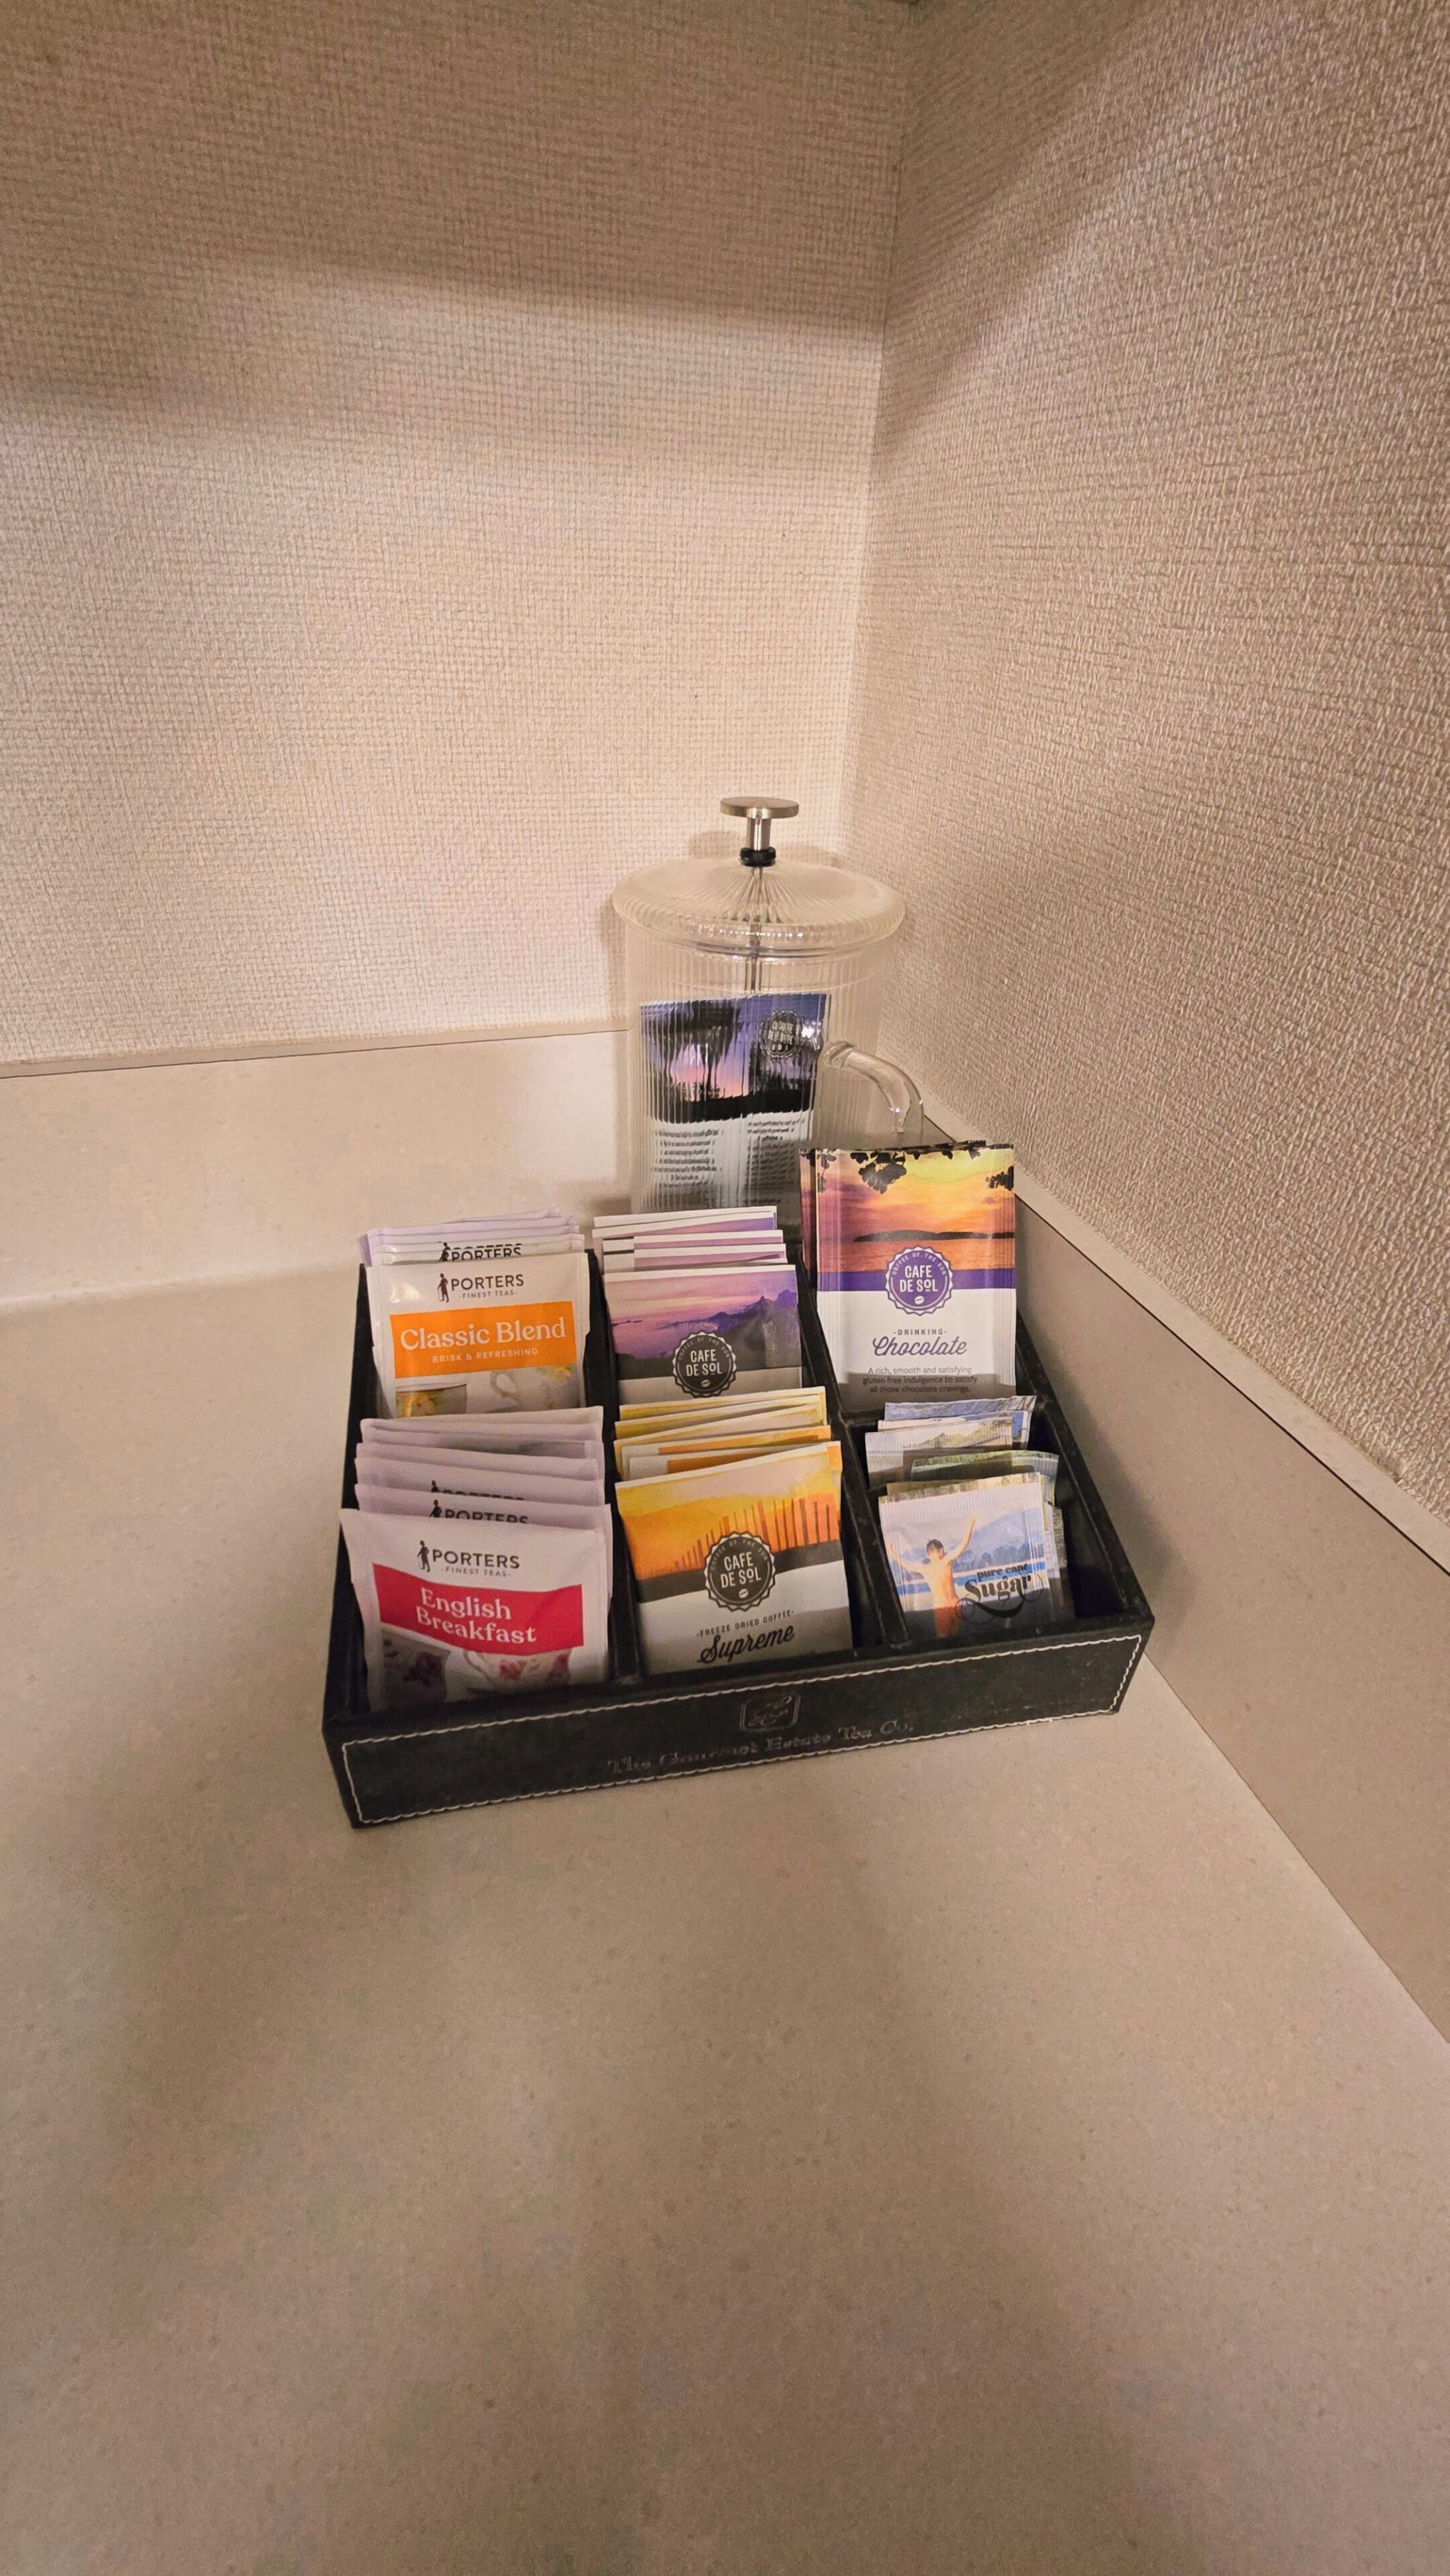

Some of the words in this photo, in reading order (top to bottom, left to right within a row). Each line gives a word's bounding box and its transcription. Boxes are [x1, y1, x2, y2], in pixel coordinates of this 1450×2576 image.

[905, 1265, 932, 1279] CAFE
[451, 1274, 524, 1291] PORTERS
[899, 1279, 913, 1293] DE
[400, 1324, 490, 1350] Classic
[496, 1316, 566, 1343] Blend
[873, 1336, 967, 1356] Chocolate
[433, 1354, 462, 1364] BRISK
[476, 1347, 539, 1360] REFRESHING
[691, 1349, 717, 1362] CAFE
[685, 1364, 699, 1377] DE
[875, 1366, 891, 1375] rich,
[893, 1366, 921, 1375] smooth
[938, 1366, 972, 1375] satisfying
[862, 1377, 885, 1385] gluten
[903, 1376, 943, 1385] indulgence
[954, 1375, 978, 1385] satisfy
[901, 1385, 938, 1393] chocolate
[939, 1385, 970, 1393] cravings.
[433, 1549, 520, 1569] PORTERS
[724, 1552, 754, 1571] CAFE
[720, 1572, 736, 1589] DE
[977, 1568, 1003, 1582] pure
[1005, 1563, 1029, 1574] cane
[964, 1574, 1032, 1604] Sugar
[421, 1587, 512, 1620] English
[416, 1606, 537, 1644] Breakfast
[735, 1618, 760, 1630] DRIED
[697, 1625, 795, 1664] Supreme
[607, 1756, 652, 1774] The
[765, 1733, 831, 1752] Estate
[838, 1725, 872, 1740] Tea
[880, 1719, 914, 1735] Co.
